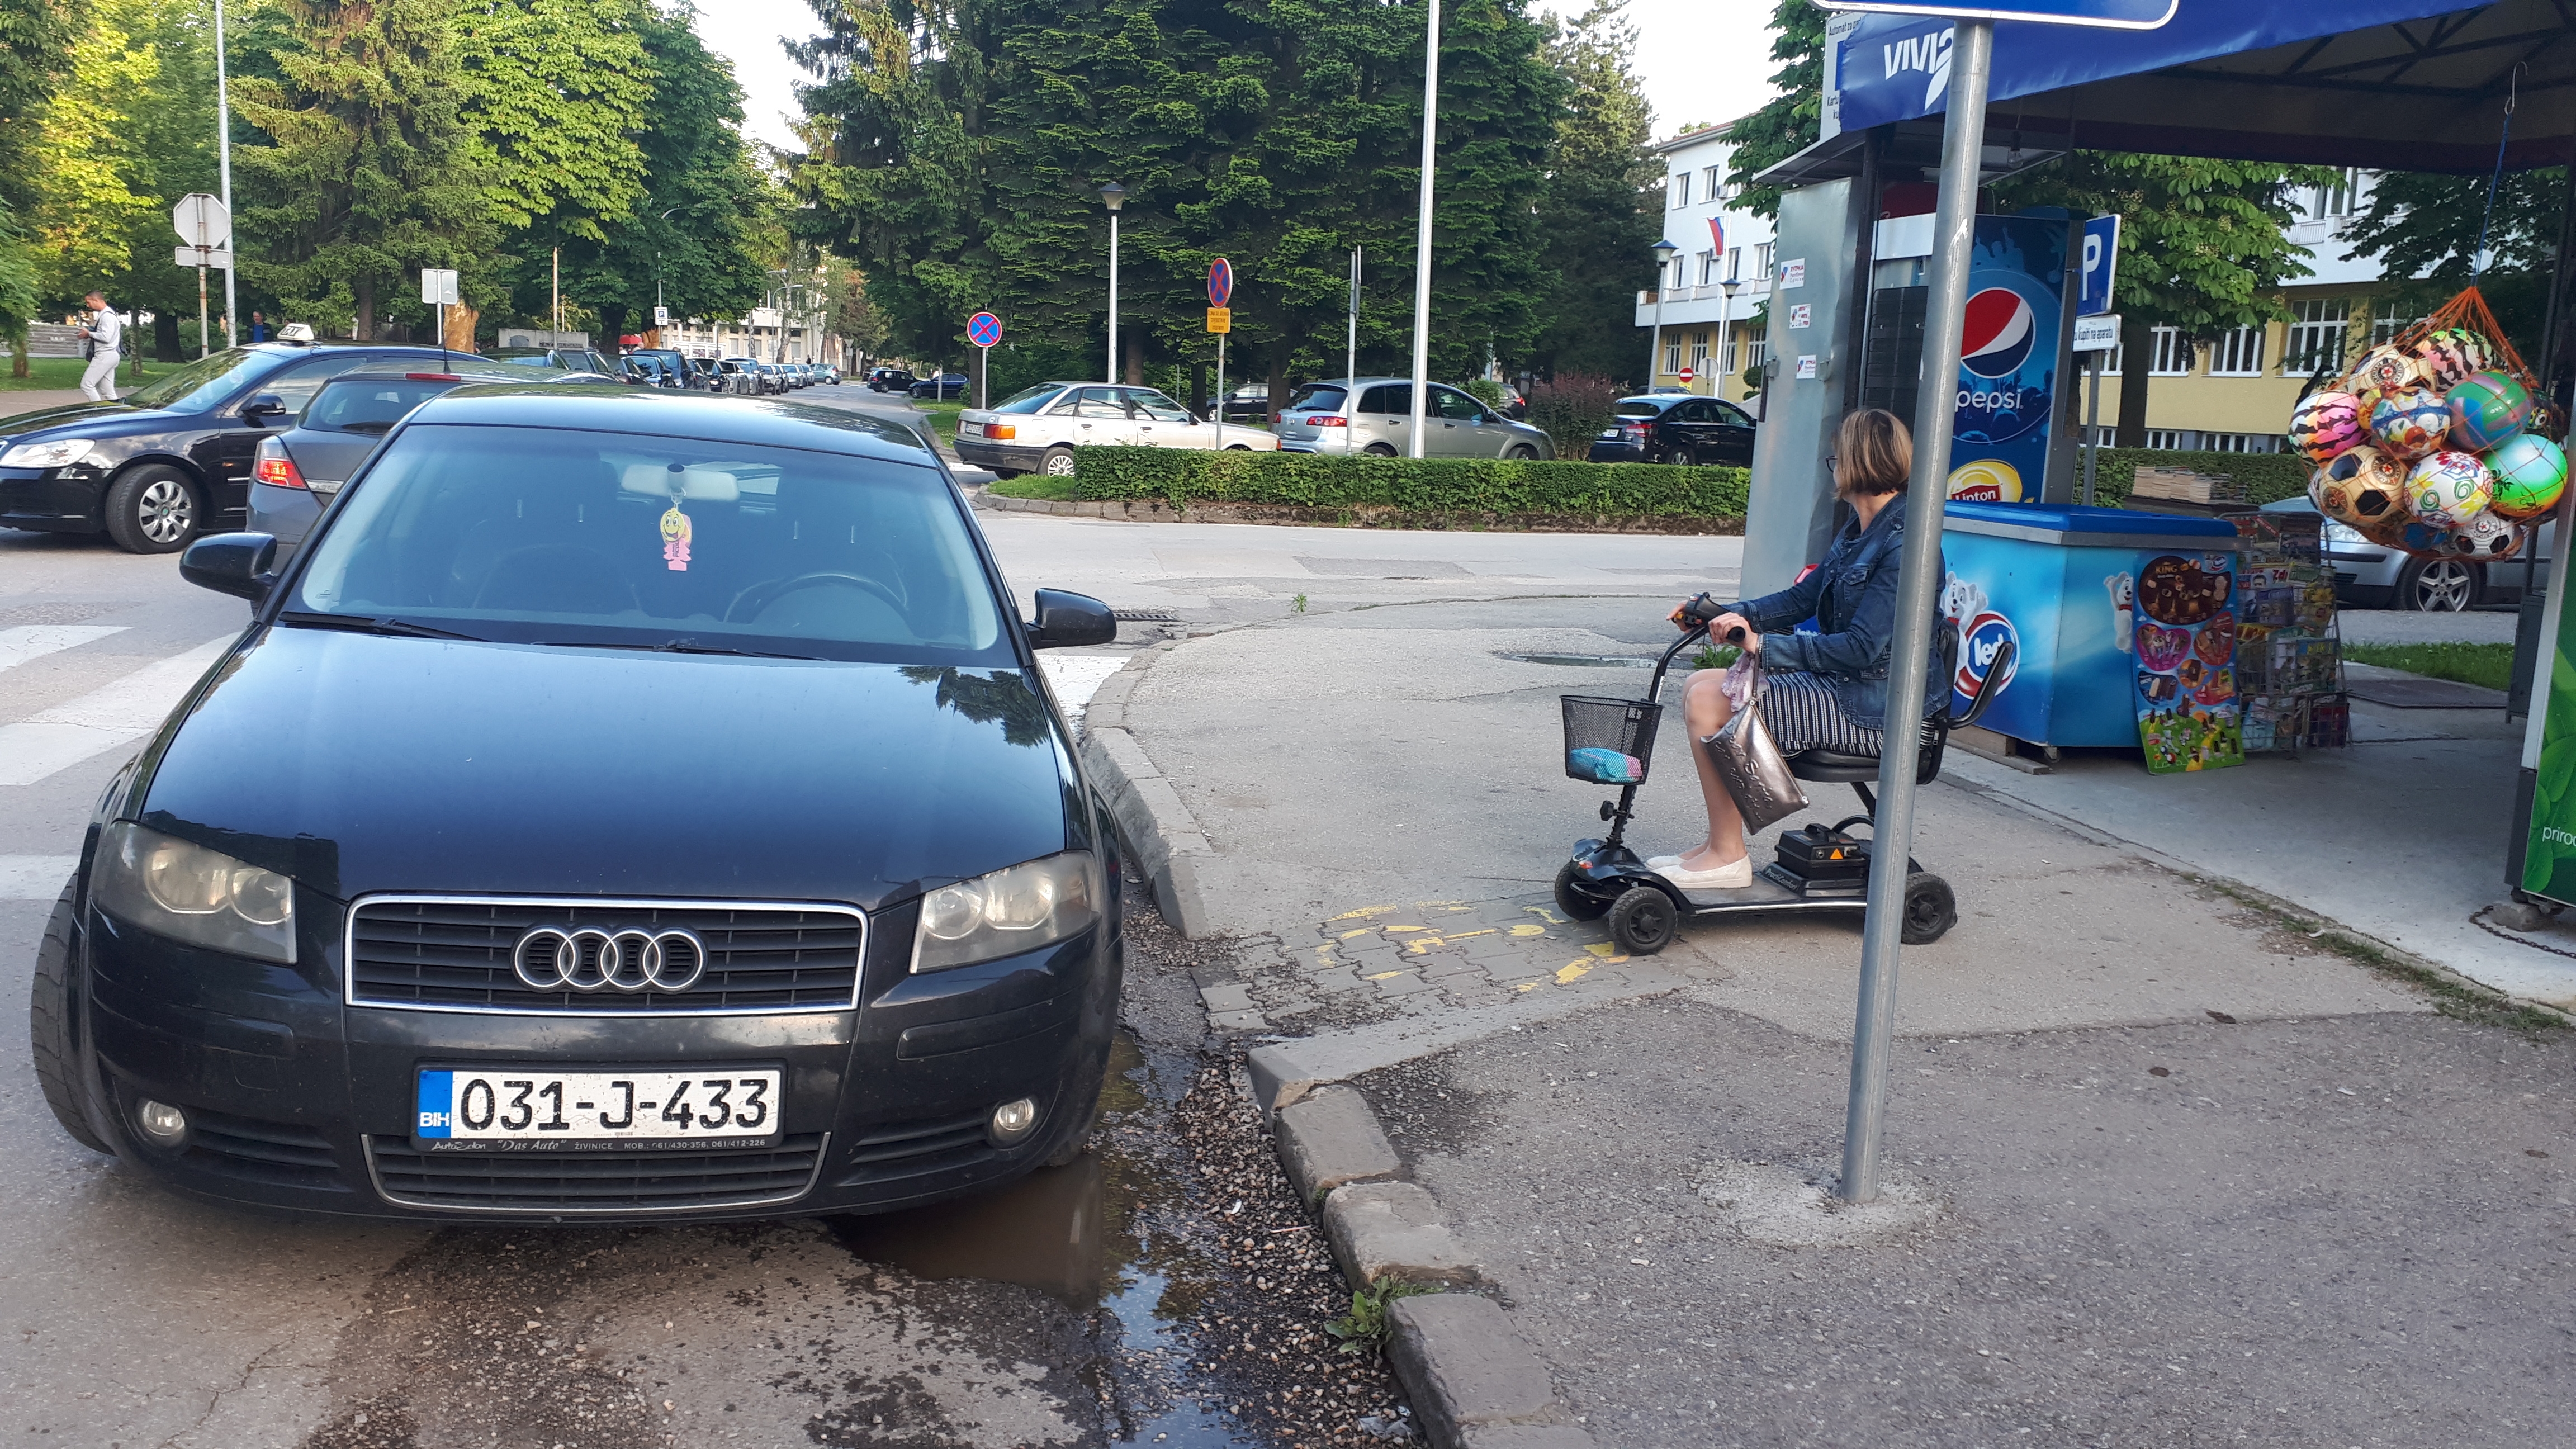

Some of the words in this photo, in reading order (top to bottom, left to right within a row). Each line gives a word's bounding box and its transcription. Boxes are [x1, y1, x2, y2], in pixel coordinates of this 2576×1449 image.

[2082, 234, 2102, 301] P
[1955, 389, 2021, 413] pepsi
[1974, 633, 2005, 667] led
[461, 1079, 768, 1130] 031-J-433
[420, 1112, 450, 1127] BIH
[574, 1140, 613, 1150] ŽIVINICE
[712, 1139, 765, 1148] 061/412-226
